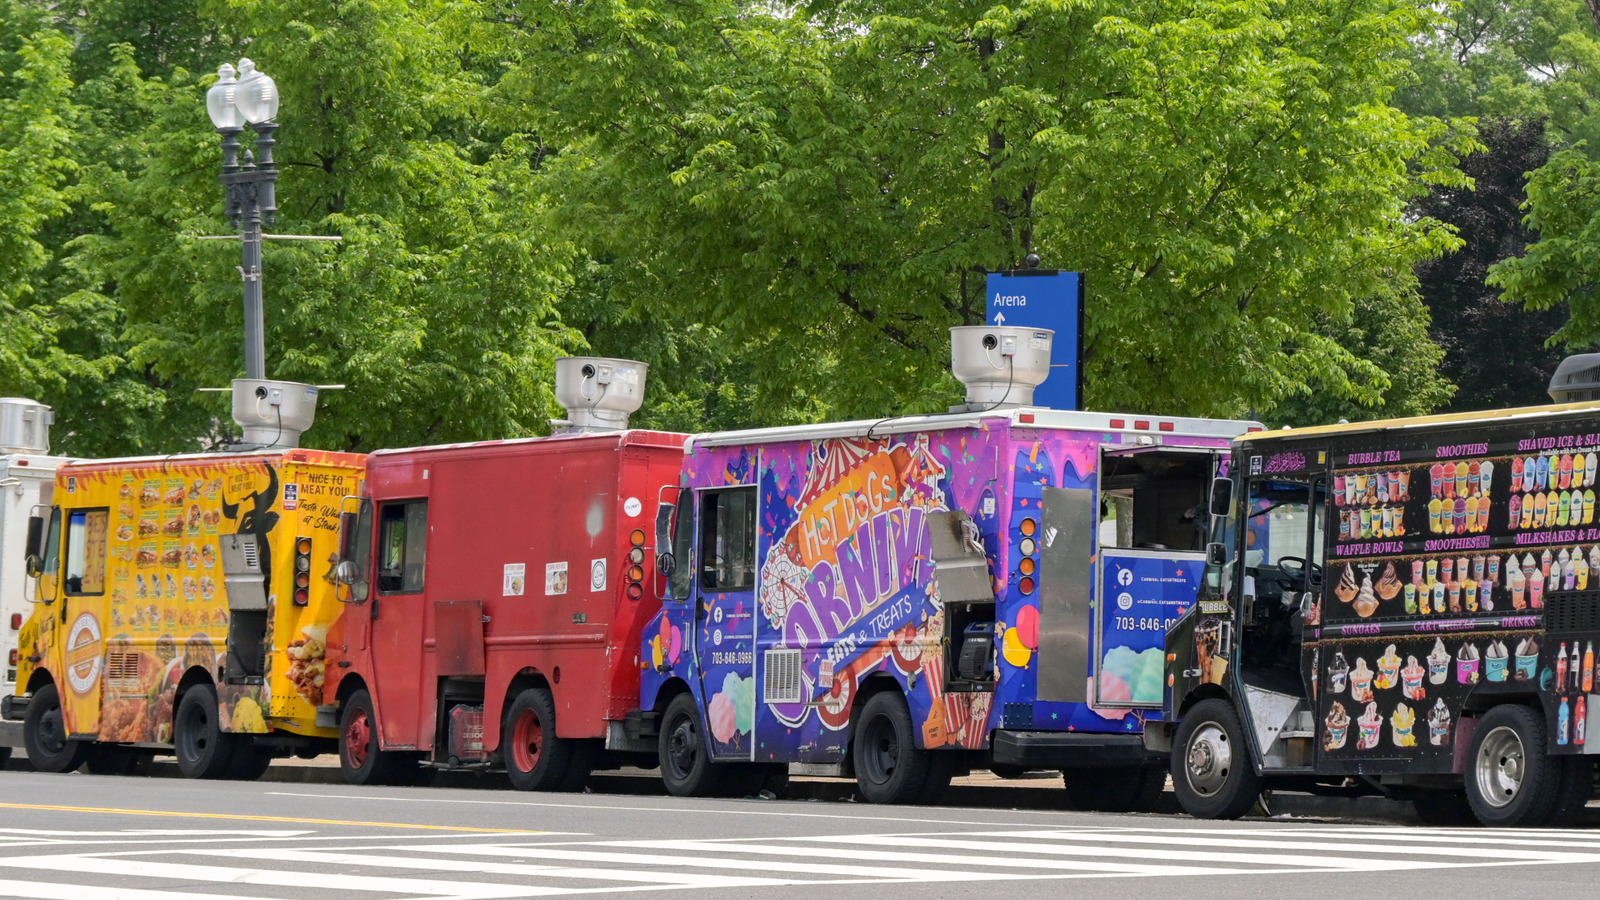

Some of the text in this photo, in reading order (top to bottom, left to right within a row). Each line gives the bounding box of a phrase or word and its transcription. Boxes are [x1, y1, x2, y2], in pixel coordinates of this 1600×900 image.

[994, 293, 1026, 306] Arena
[1518, 437, 1555, 451] SHAVED
[1558, 435, 1573, 447] ICE
[1575, 434, 1583, 446] &
[1348, 450, 1400, 465] BUBBLE TEA
[1436, 443, 1488, 458] SMOOTHIES
[309, 473, 343, 485] NICE TO
[301, 484, 350, 496] MEAT YOU!
[298, 499, 317, 511] Taste
[803, 471, 893, 561] HOT DOGS
[303, 515, 340, 534] at Steak!
[1516, 530, 1576, 545] MILKSHAKES
[1578, 528, 1585, 541] &
[1336, 541, 1404, 556] WAFFLE BOWLS
[1424, 537, 1476, 551] SMOOTHIES
[1199, 601, 1228, 612] BUBBLE
[869, 594, 912, 637] TREATS
[1502, 616, 1537, 628] DRINKS
[1341, 623, 1381, 635] SUNDAES
[827, 630, 867, 664] EATS &
[712, 651, 752, 665] 703-646-0966
[928, 726, 939, 734] ADMIT
